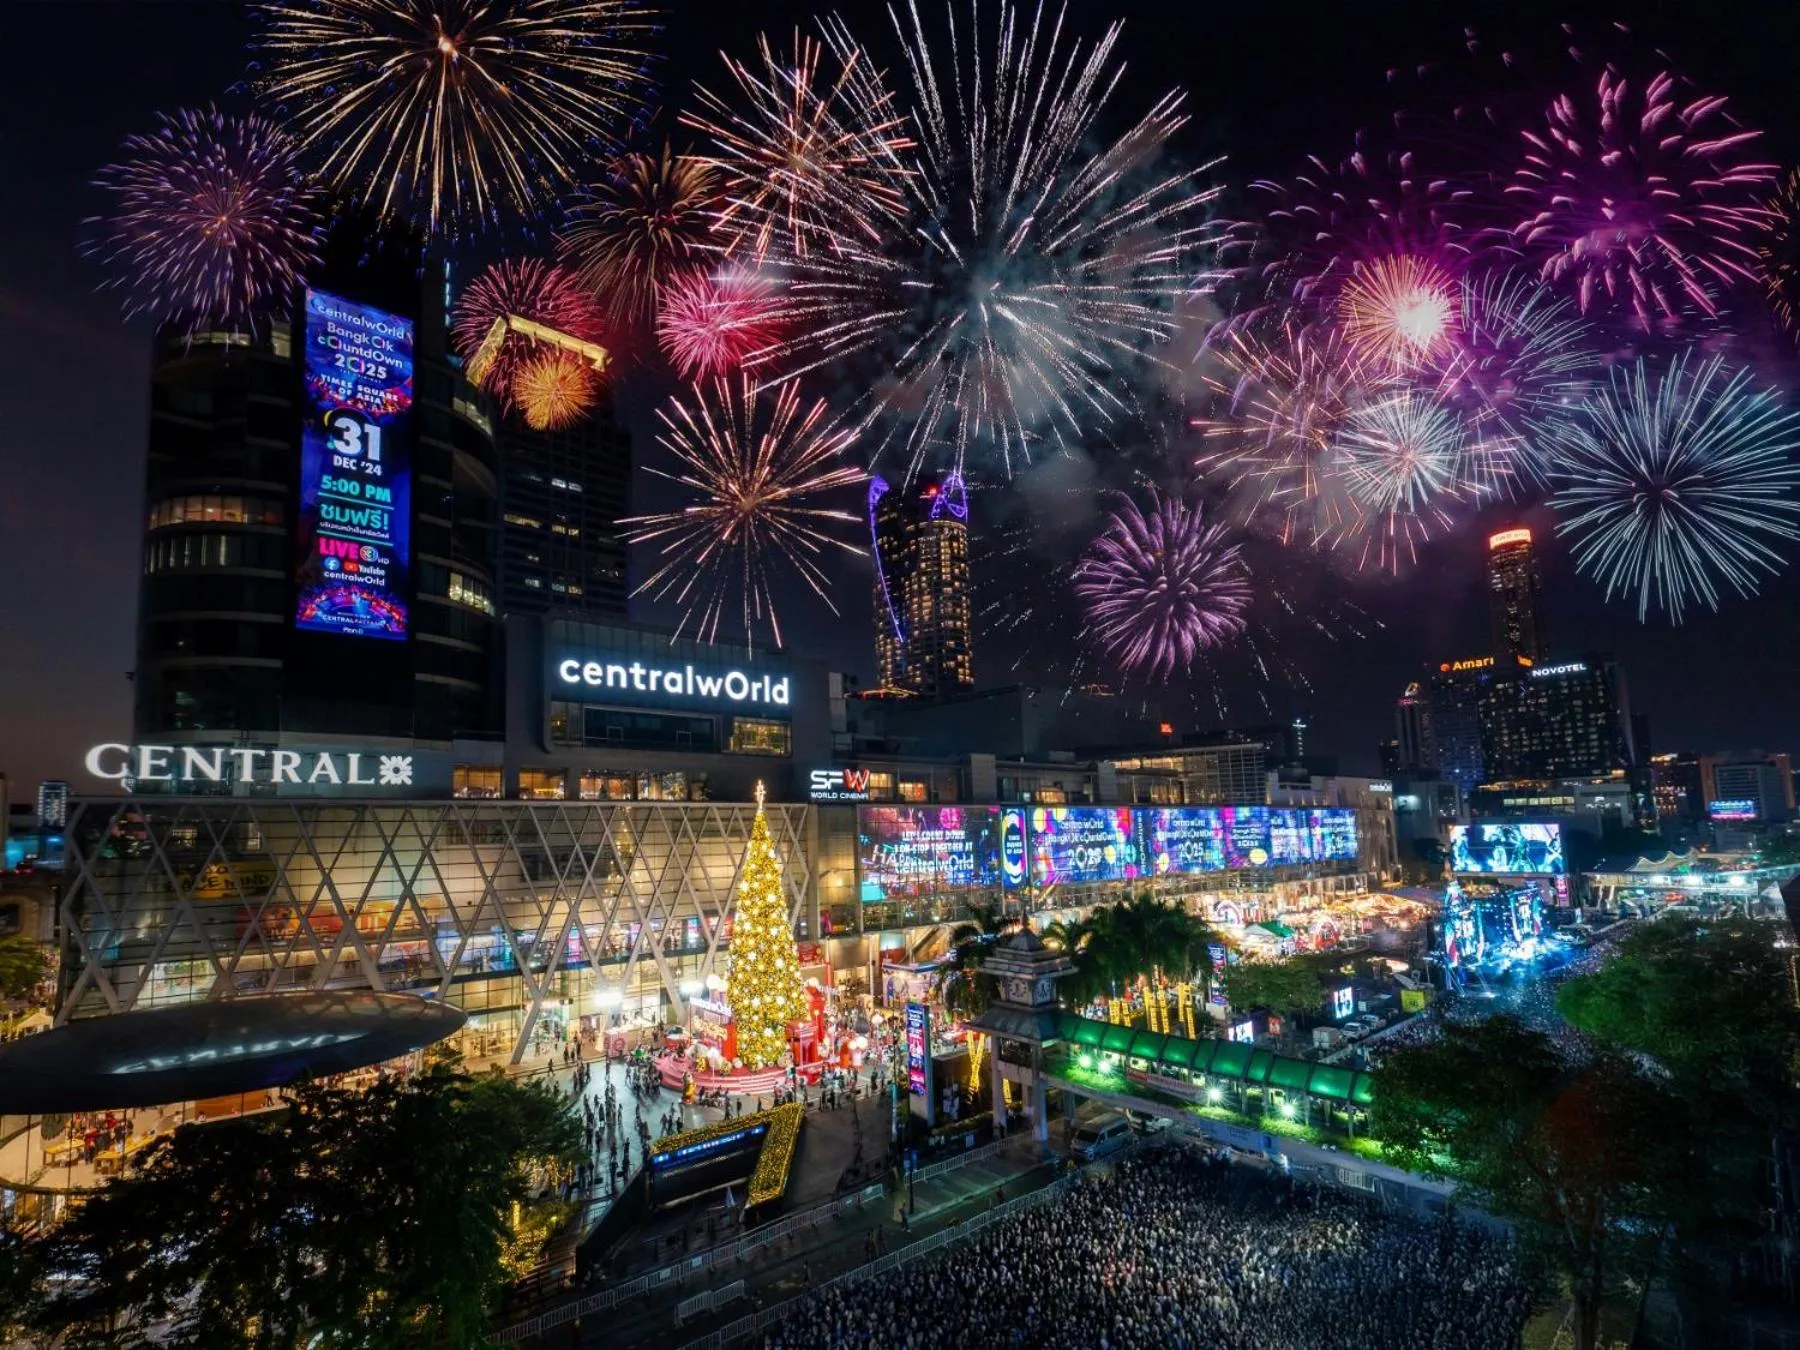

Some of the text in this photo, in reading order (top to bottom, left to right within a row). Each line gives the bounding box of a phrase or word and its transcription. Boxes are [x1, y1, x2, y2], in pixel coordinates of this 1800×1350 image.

[317, 304, 405, 340] centralwOrld
[327, 321, 395, 352] BangkOk
[317, 335, 403, 368] cOuntdOwn
[334, 353, 388, 380] 2025
[320, 373, 353, 389] TIMES
[357, 384, 399, 402] SQUARE
[333, 417, 381, 461] 31
[333, 455, 383, 476] DEC '24
[320, 474, 392, 503] 5:00 PM
[318, 537, 359, 560] LIVE
[323, 571, 385, 587] centralwOrld
[1452, 657, 1495, 671] Amari
[1532, 664, 1588, 677] NOVOTEL
[559, 657, 790, 705] centralwOrld
[84, 742, 375, 793] CENTRAL
[810, 791, 839, 799] WORLD
[894, 853, 975, 873] centralwOrld
